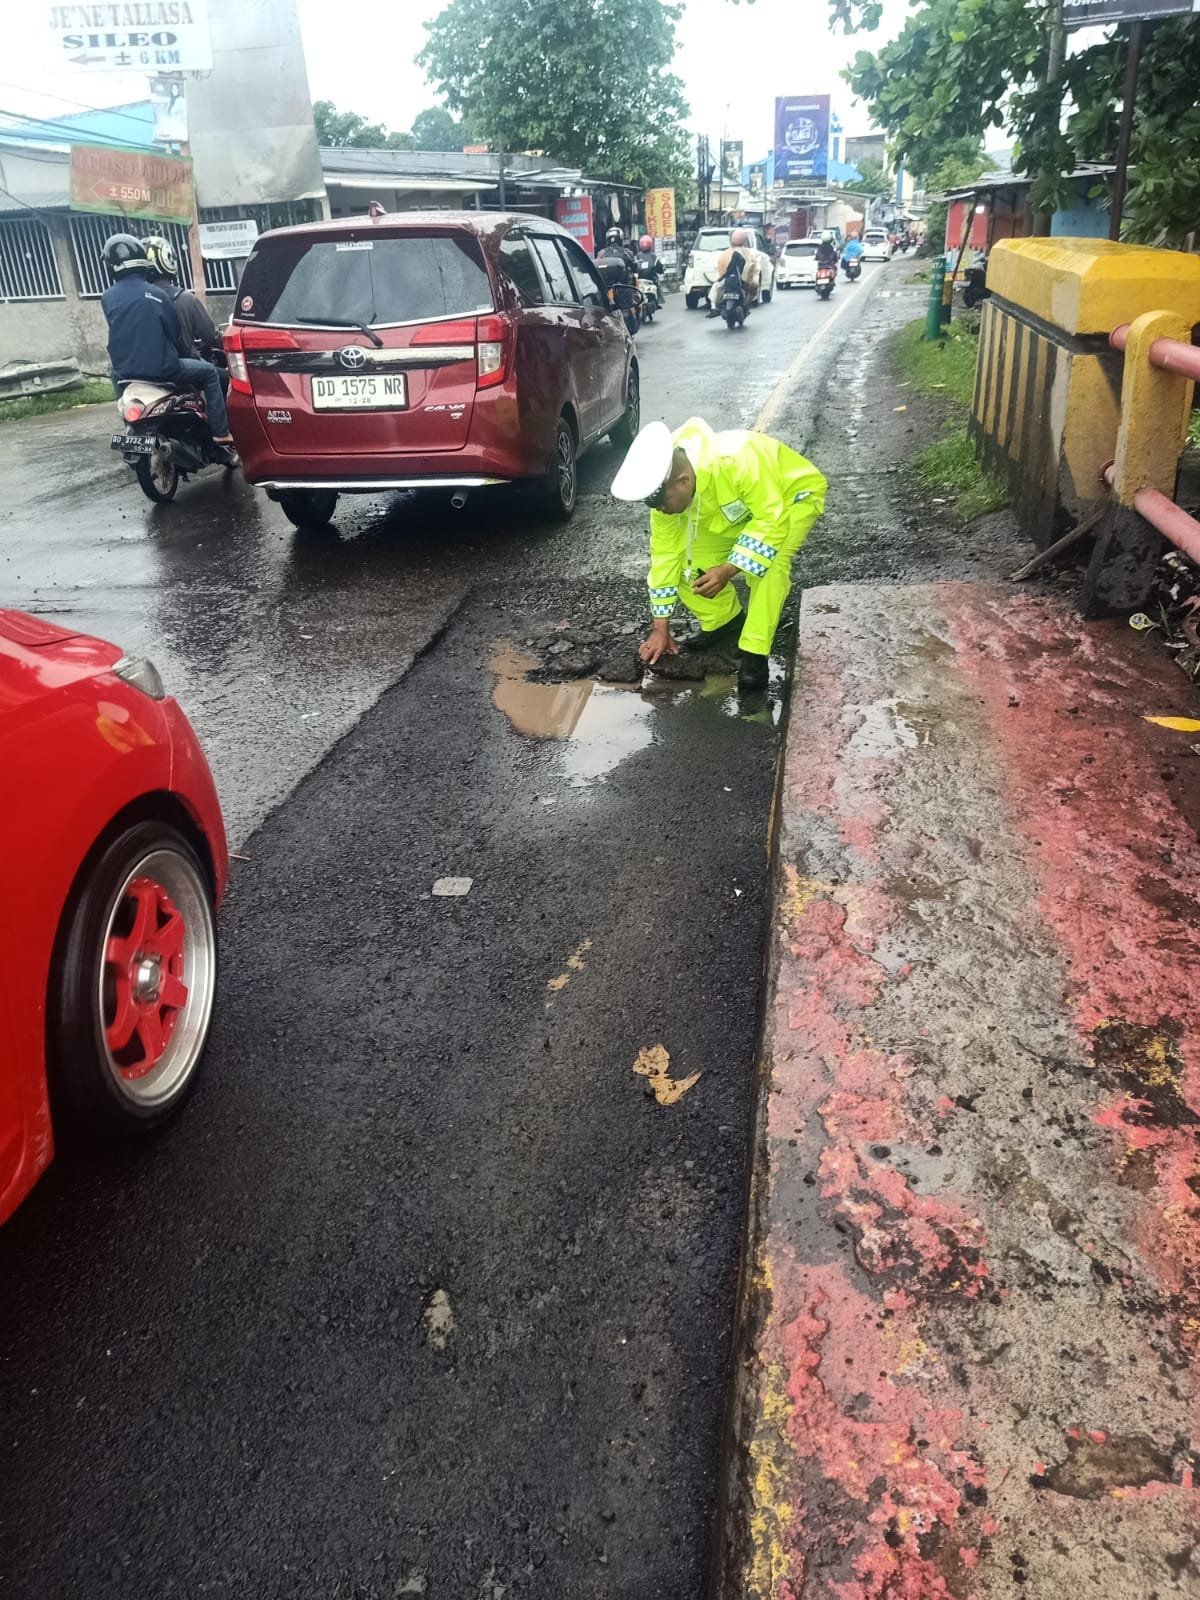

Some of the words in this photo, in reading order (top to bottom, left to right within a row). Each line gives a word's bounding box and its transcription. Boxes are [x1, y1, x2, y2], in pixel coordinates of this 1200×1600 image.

[62, 32, 177, 48] SILEO
[139, 50, 149, 64] 6
[155, 50, 181, 64] KM
[661, 193, 673, 236] SADEL
[317, 380, 335, 396] DD
[341, 378, 376, 396] 1575
[384, 377, 402, 394] NR
